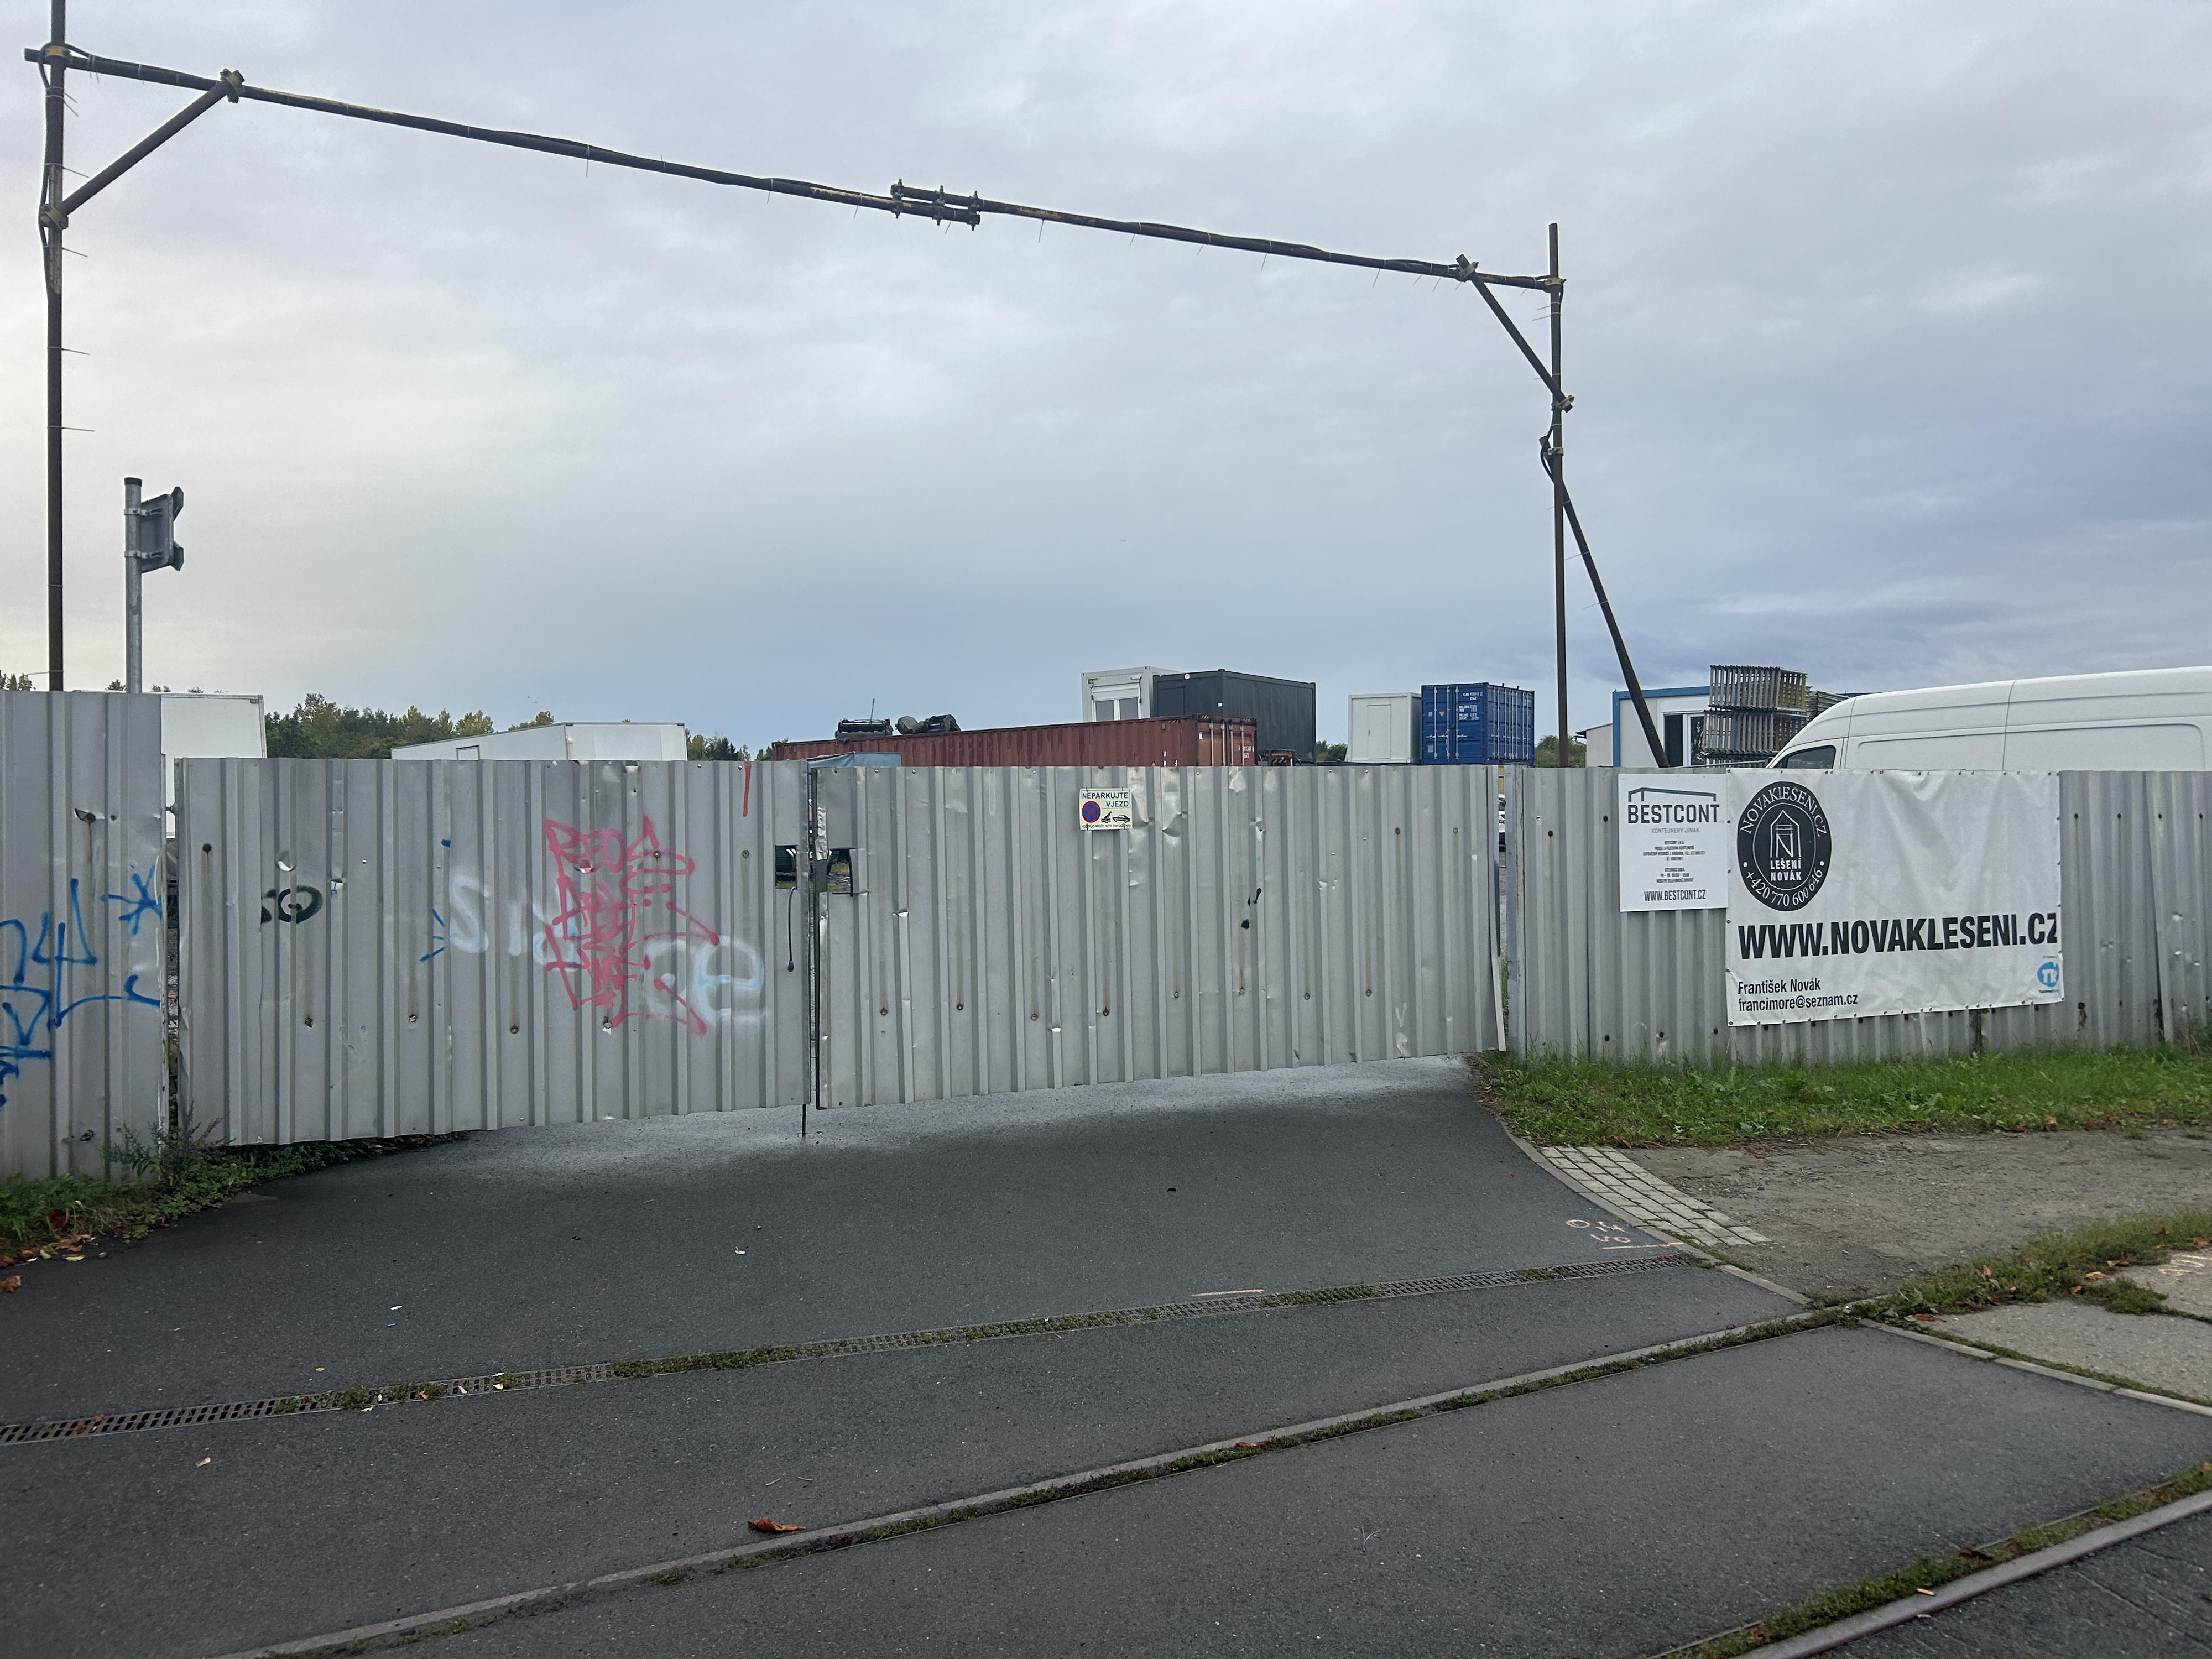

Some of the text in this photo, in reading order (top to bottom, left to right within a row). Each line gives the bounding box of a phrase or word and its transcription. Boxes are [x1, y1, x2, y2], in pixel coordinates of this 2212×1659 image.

[1627, 804, 1719, 823] BESTCONT
[1771, 869, 1802, 881] NOVÁK
[1644, 889, 1706, 901] WWW.BESTCONT.CZ
[1746, 867, 1823, 907] +420 770 600 646
[1738, 912, 2057, 960] WWW.NOVAKLESENI.CZ
[1738, 977, 1821, 994] František Novák
[1739, 994, 1858, 1011] francimore@seznam.cz
